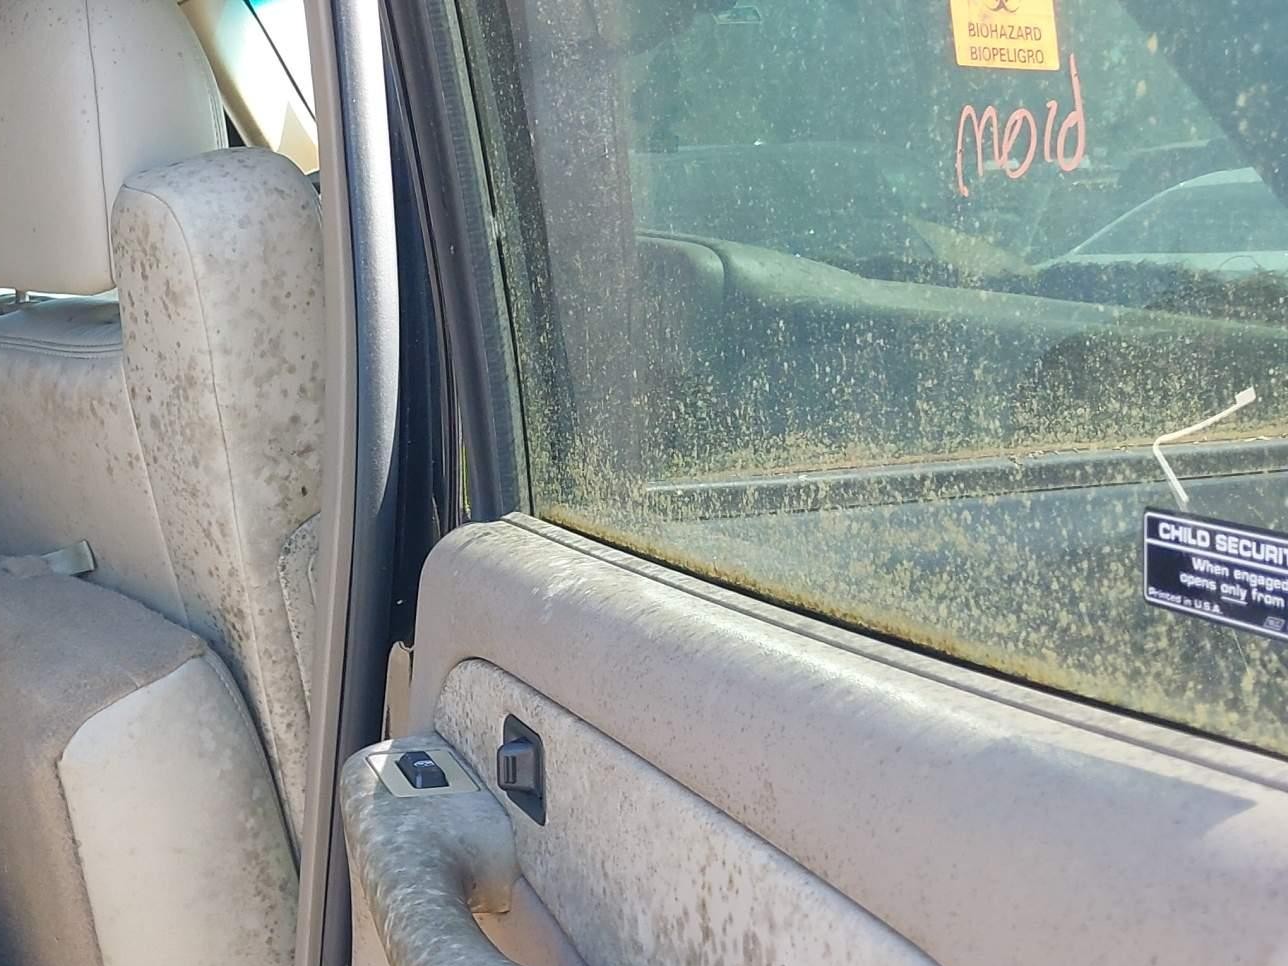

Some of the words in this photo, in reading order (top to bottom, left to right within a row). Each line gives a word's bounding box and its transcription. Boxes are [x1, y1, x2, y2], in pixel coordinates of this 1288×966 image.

[967, 22, 1042, 41] BIOHAZARD
[970, 46, 1044, 64] BIOPELIGRO
[1158, 522, 1210, 547] CHILD
[1192, 556, 1230, 577] When
[1148, 586, 1182, 603] Printed
[1184, 596, 1193, 606] in
[1179, 572, 1216, 591] opens
[1220, 583, 1248, 601] only
[1251, 588, 1285, 608] from
